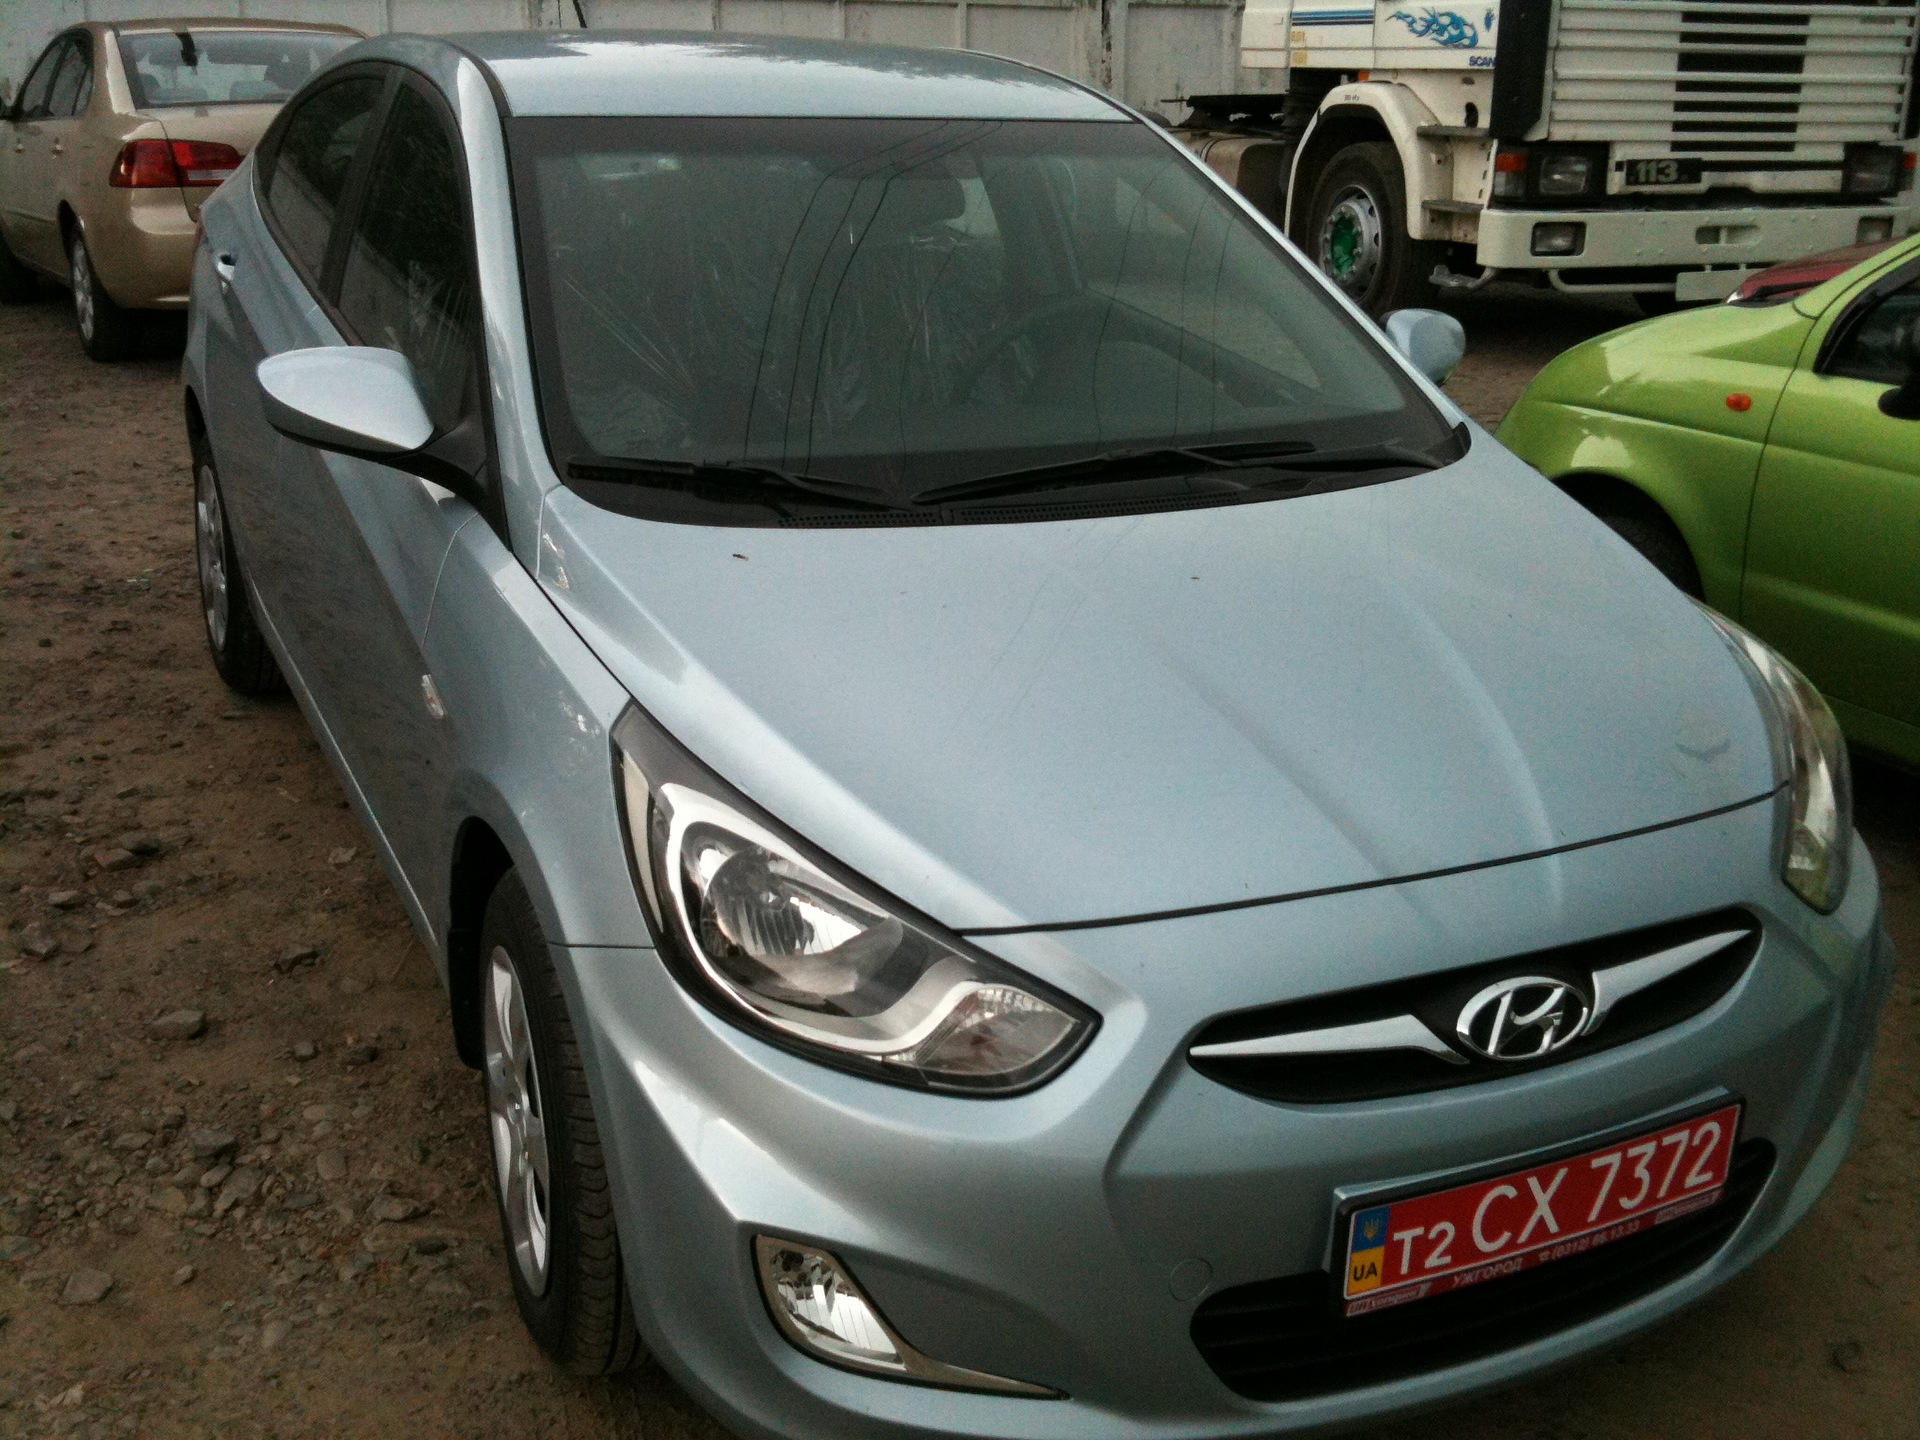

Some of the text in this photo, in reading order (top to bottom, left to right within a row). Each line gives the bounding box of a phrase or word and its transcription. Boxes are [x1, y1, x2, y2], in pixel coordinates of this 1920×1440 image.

[1636, 160, 1678, 183] 113
[1393, 1221, 1455, 1275] T2
[1472, 1167, 1568, 1252] CX
[1587, 1121, 1721, 1222] 7372
[1353, 1262, 1378, 1281] UA
